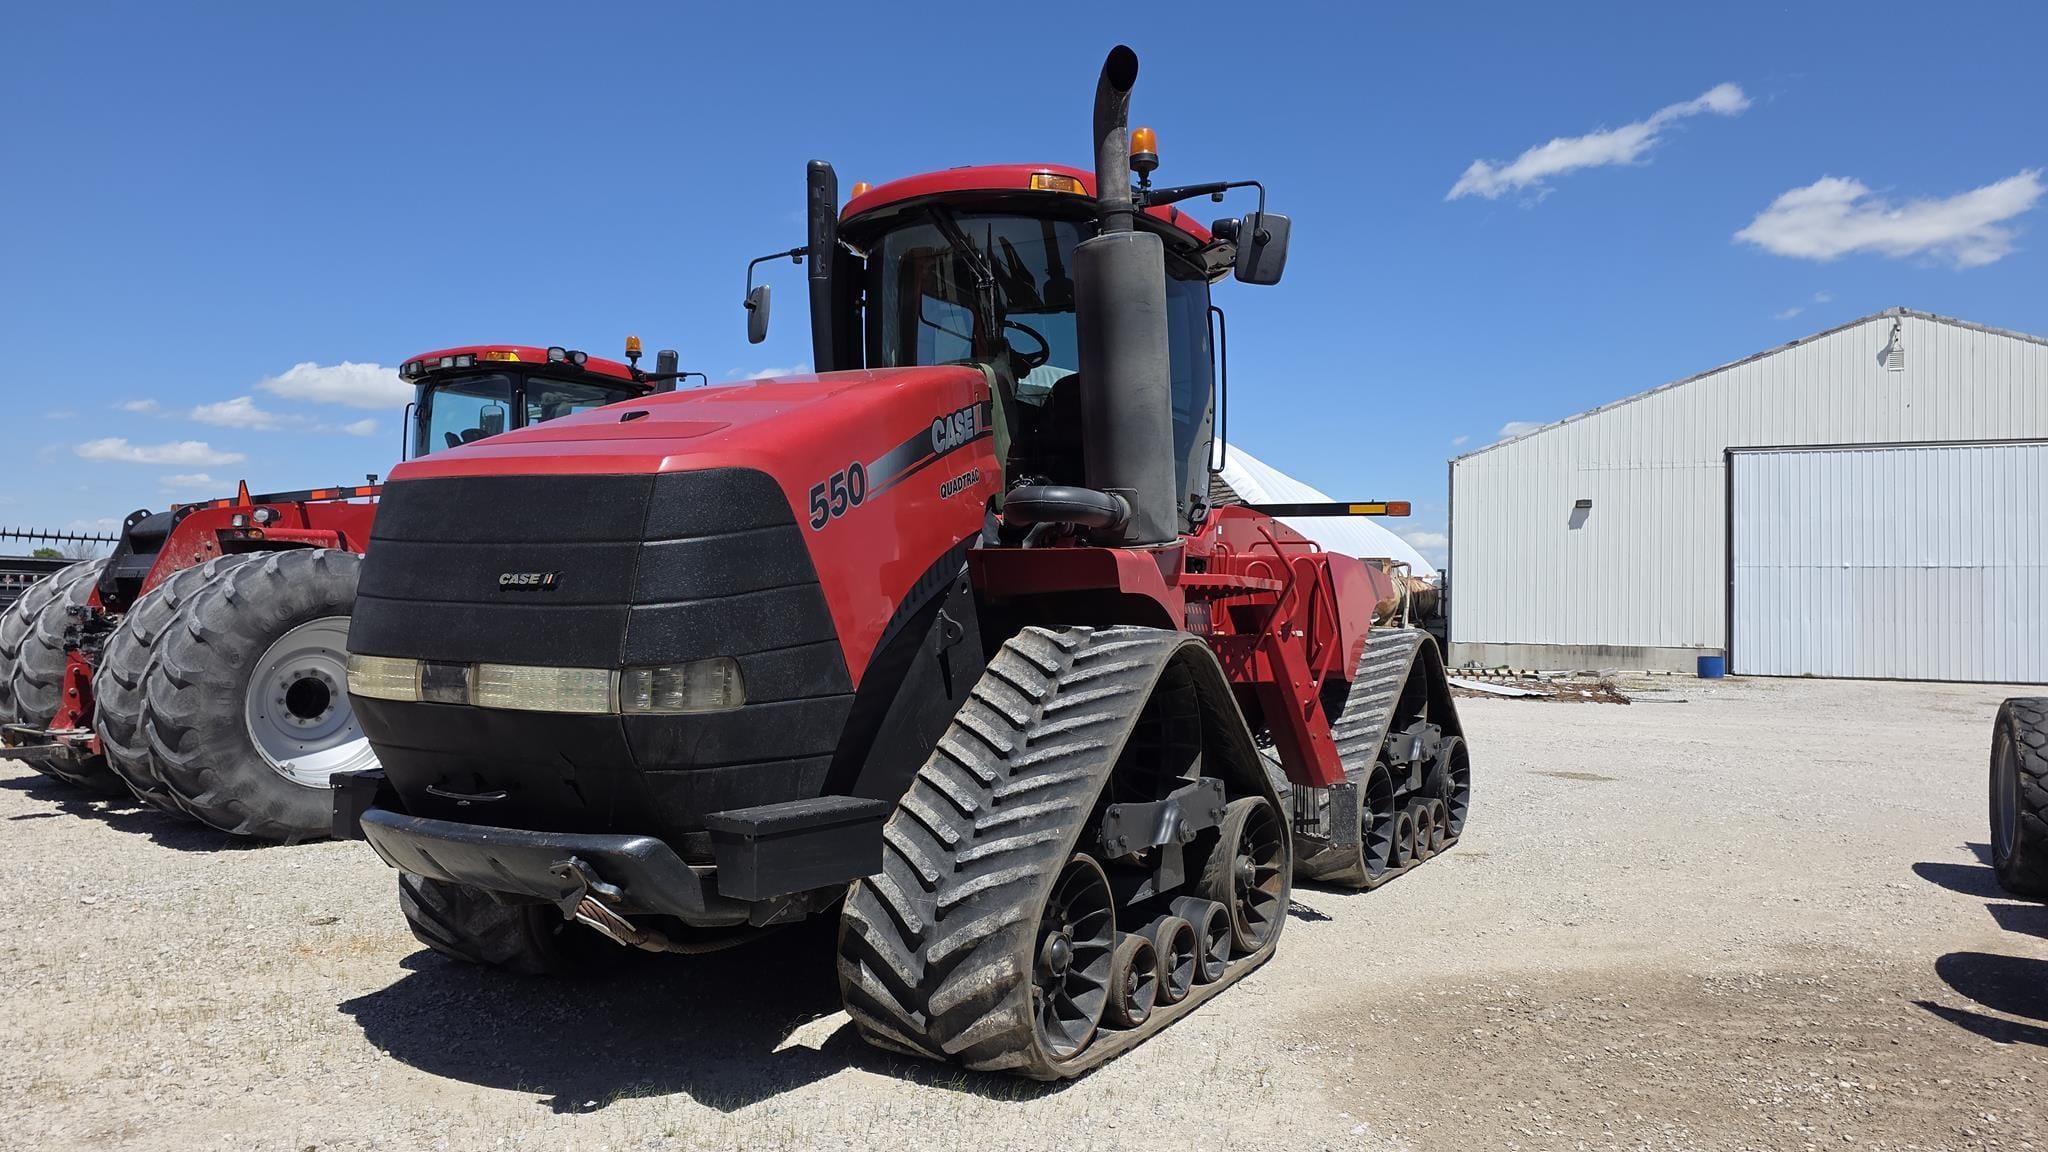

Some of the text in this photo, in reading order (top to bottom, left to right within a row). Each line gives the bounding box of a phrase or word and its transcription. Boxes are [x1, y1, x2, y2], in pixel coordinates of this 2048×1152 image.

[931, 408, 974, 453] CASE
[809, 460, 865, 531] 550
[940, 467, 980, 500] QUADTRAC
[499, 573, 541, 585] CASE
